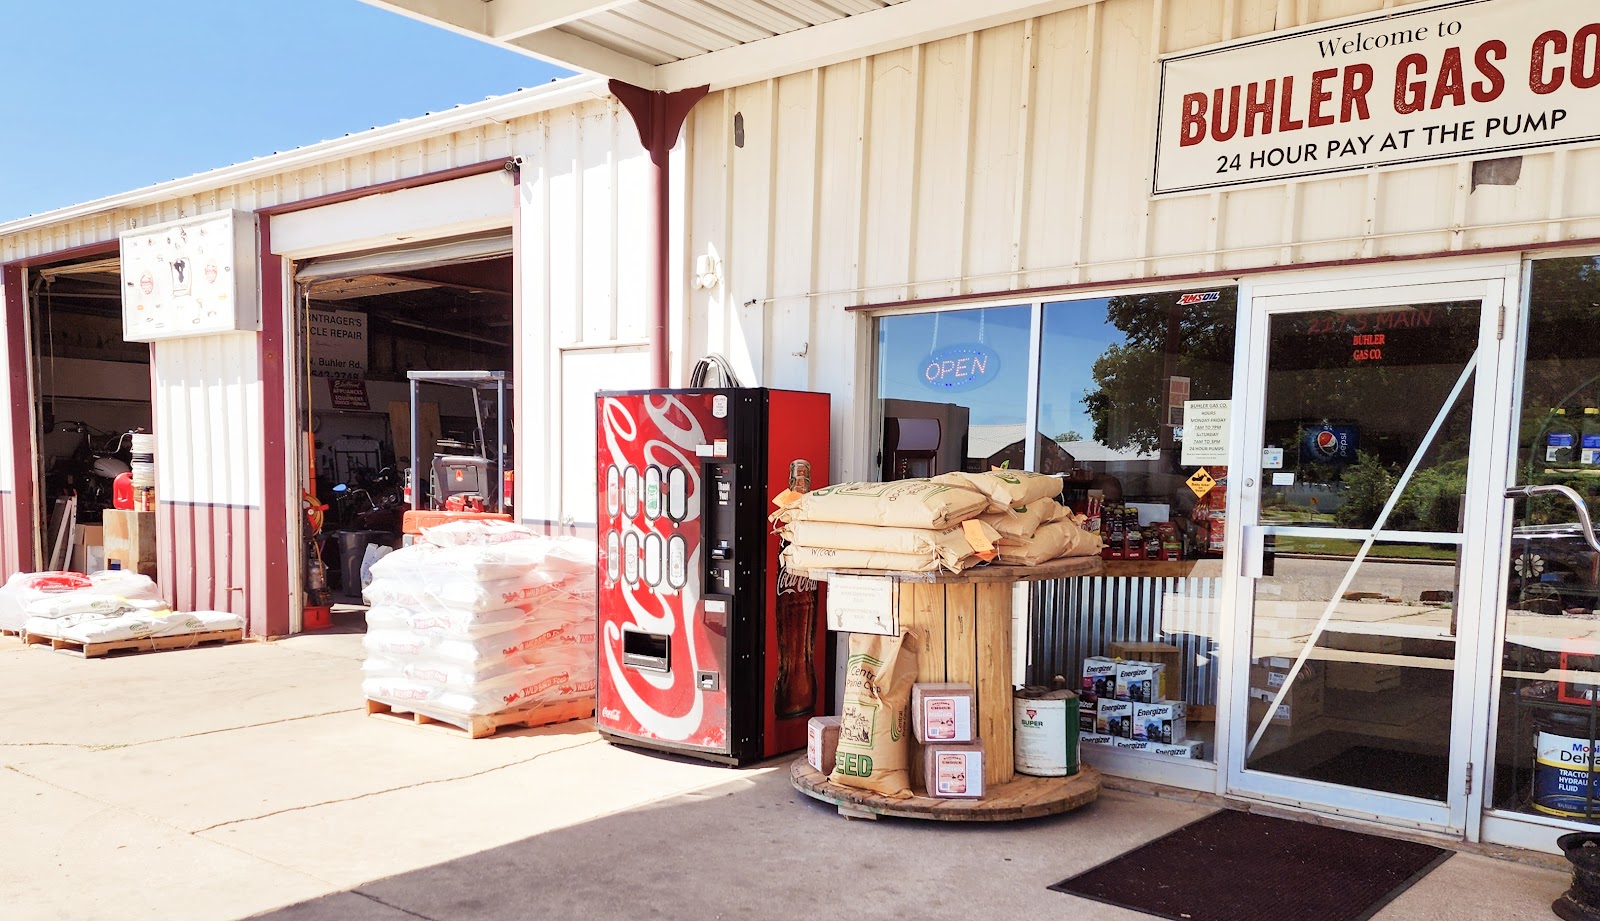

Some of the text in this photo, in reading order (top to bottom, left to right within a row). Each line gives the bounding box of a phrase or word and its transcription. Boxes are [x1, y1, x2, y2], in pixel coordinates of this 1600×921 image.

[1318, 20, 1462, 59] Welcome to
[1179, 63, 1374, 147] BUHLER
[1393, 39, 1507, 115] GAS
[1216, 109, 1568, 174] 24 HOUR PAY AT THE PUMP
[1179, 292, 1218, 304] AMSOIL
[1308, 307, 1433, 334] 217 S MAIN
[330, 328, 362, 340] REPAIR
[1353, 334, 1385, 346] BUHLER
[1353, 348, 1383, 361] GAS CO.
[319, 357, 346, 368] Buhler
[925, 355, 988, 381] OPEN
[1340, 432, 1348, 457] pepsi
[851, 665, 877, 681] Centr
[1086, 664, 1113, 674] Energizer
[1120, 669, 1148, 678] Energizer
[1101, 704, 1127, 712] Energizer
[1137, 707, 1169, 717] Energizer
[1021, 719, 1044, 727] SUPER
[1558, 784, 1579, 793] FLUID
